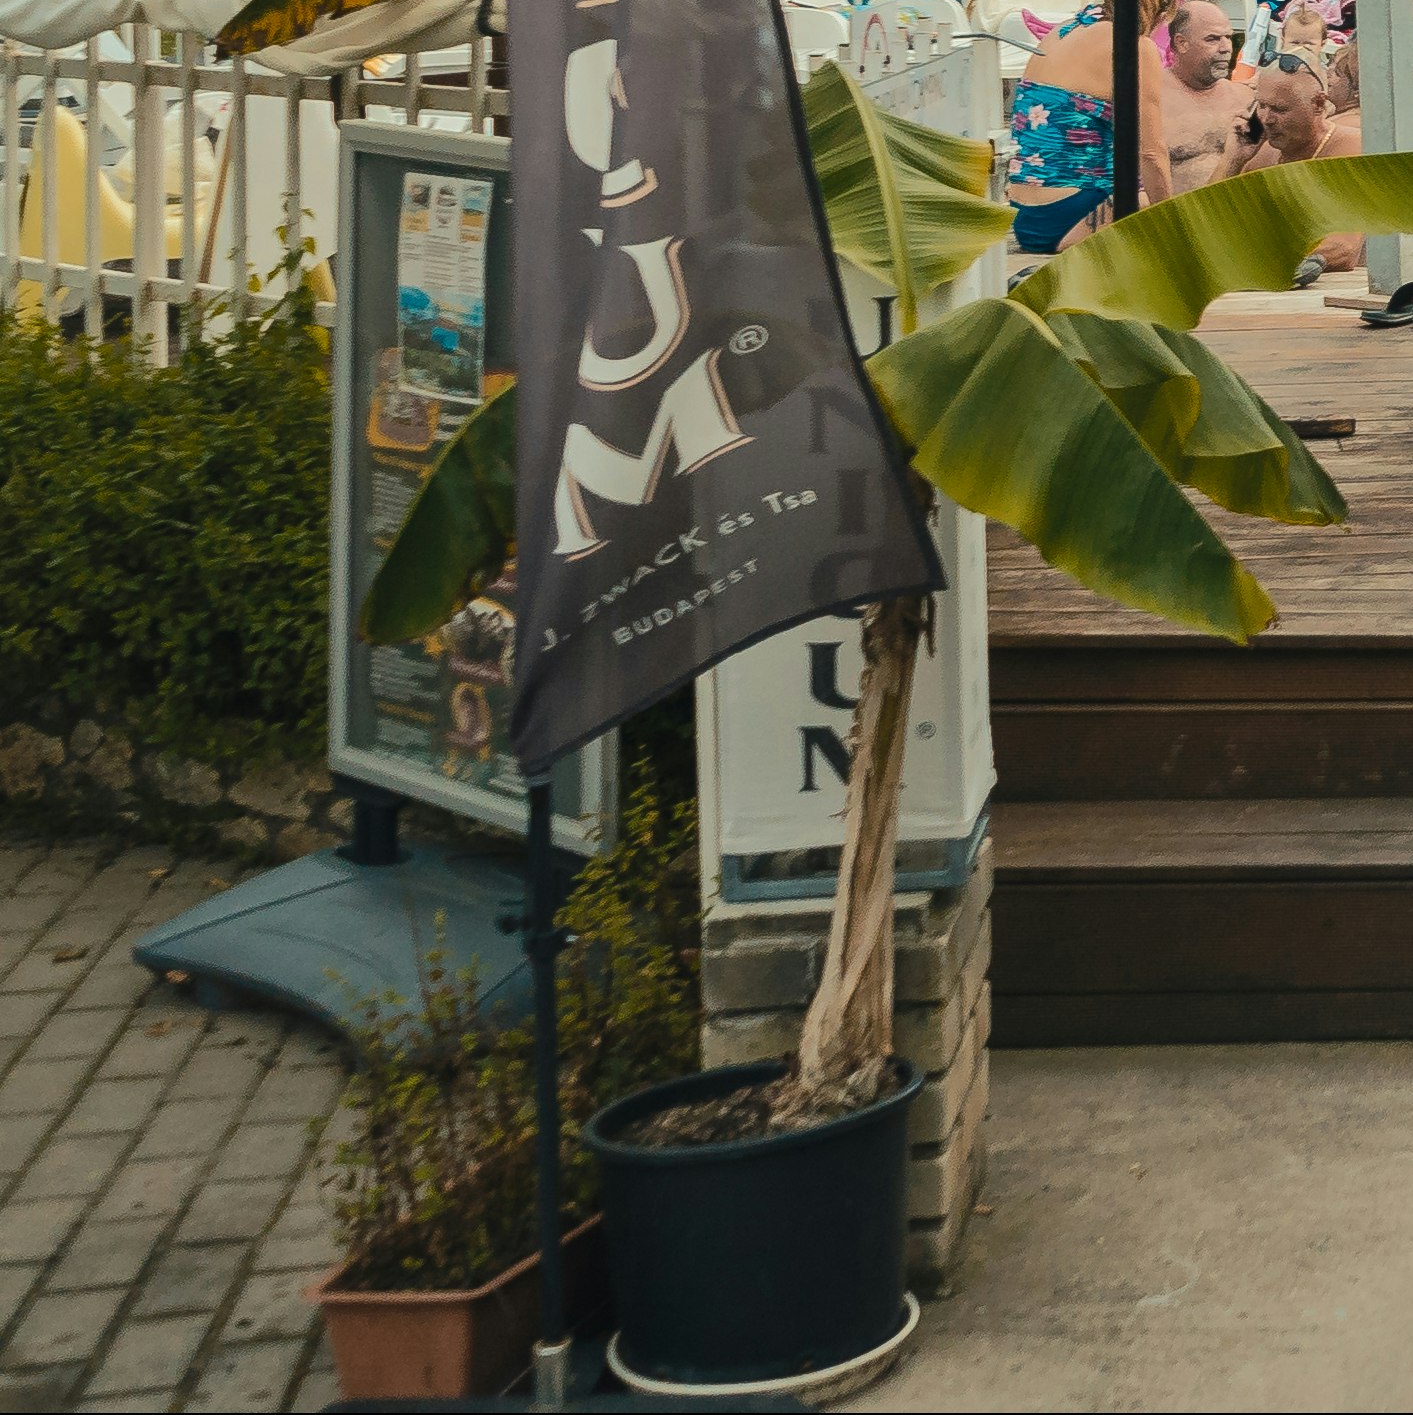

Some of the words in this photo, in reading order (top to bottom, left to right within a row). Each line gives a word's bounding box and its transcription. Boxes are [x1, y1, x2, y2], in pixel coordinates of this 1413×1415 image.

[716, 512, 755, 537] és
[761, 488, 819, 516] Tsa
[611, 558, 760, 646] BUDAPEST
